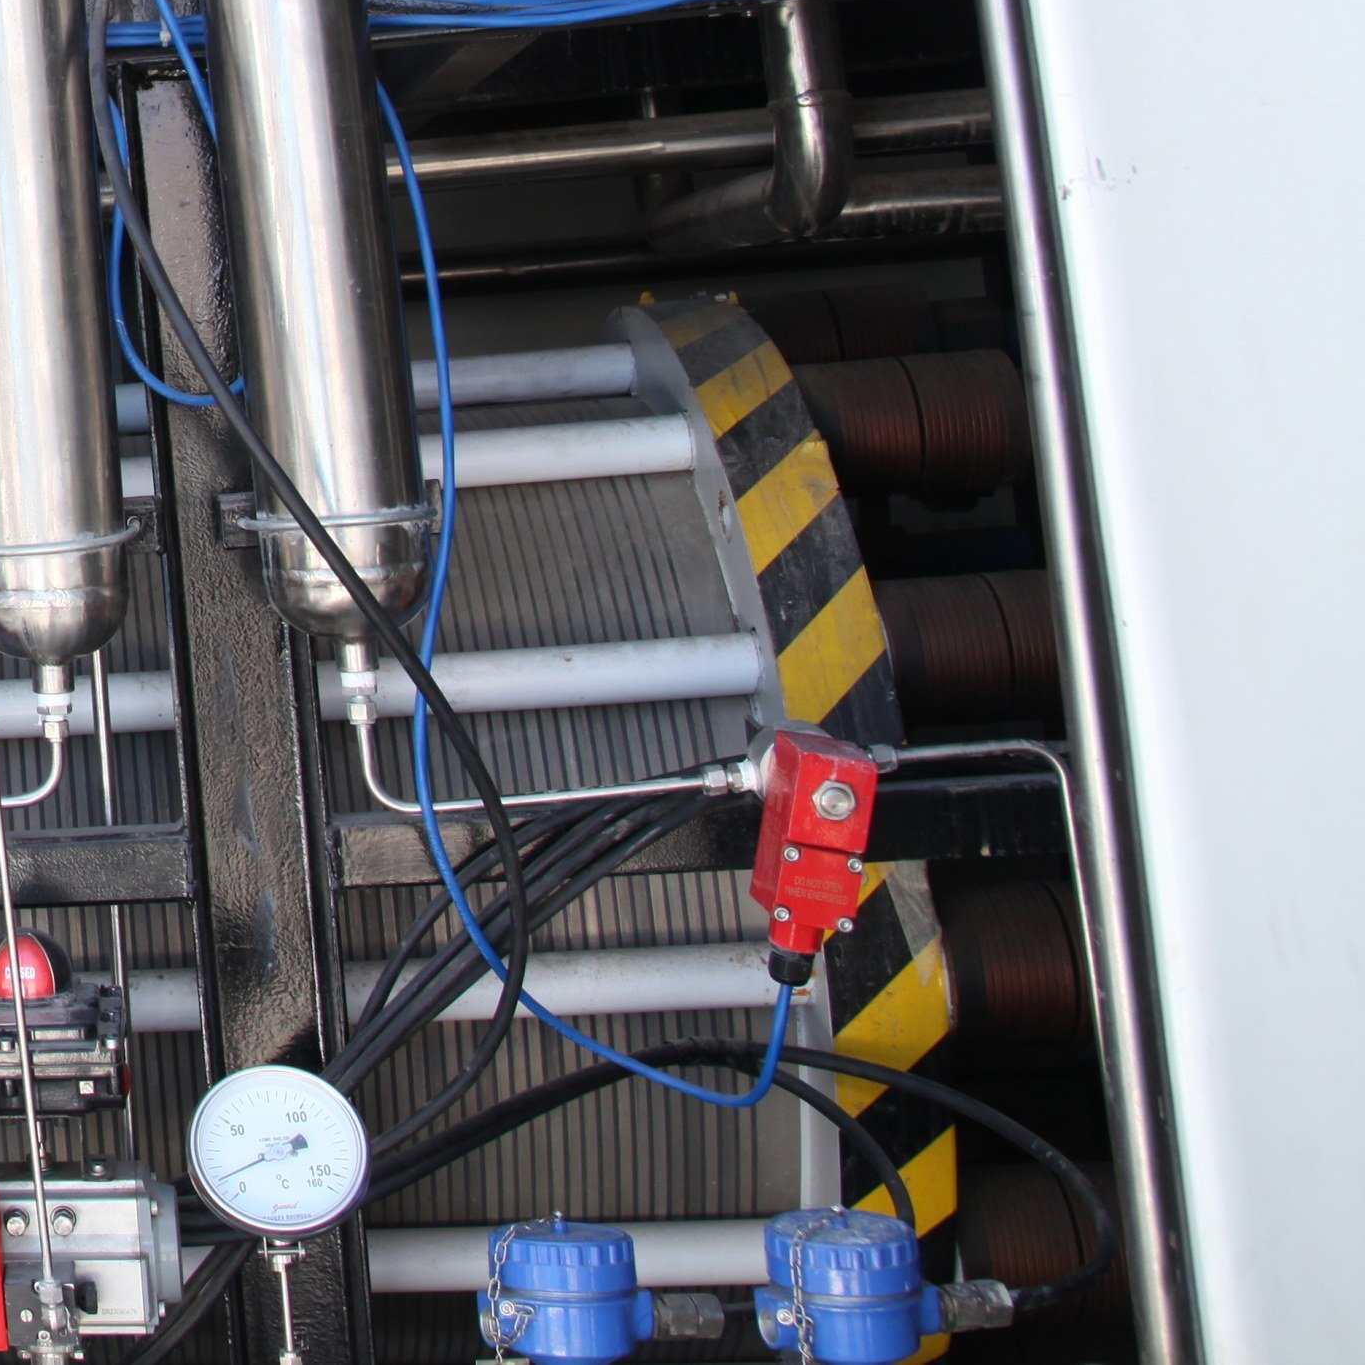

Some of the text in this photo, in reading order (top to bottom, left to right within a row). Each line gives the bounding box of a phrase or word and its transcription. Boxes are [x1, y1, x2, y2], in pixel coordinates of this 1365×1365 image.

[794, 875, 844, 893] DO NOT OPEN
[785, 885, 849, 905] WHEN ENERGISED
[4, 966, 36, 980] CSED
[284, 1110, 307, 1124] 100
[230, 1124, 245, 1137] 50
[308, 1164, 331, 1177] 150
[238, 1181, 247, 1194] 0
[306, 1178, 323, 1188] 160
